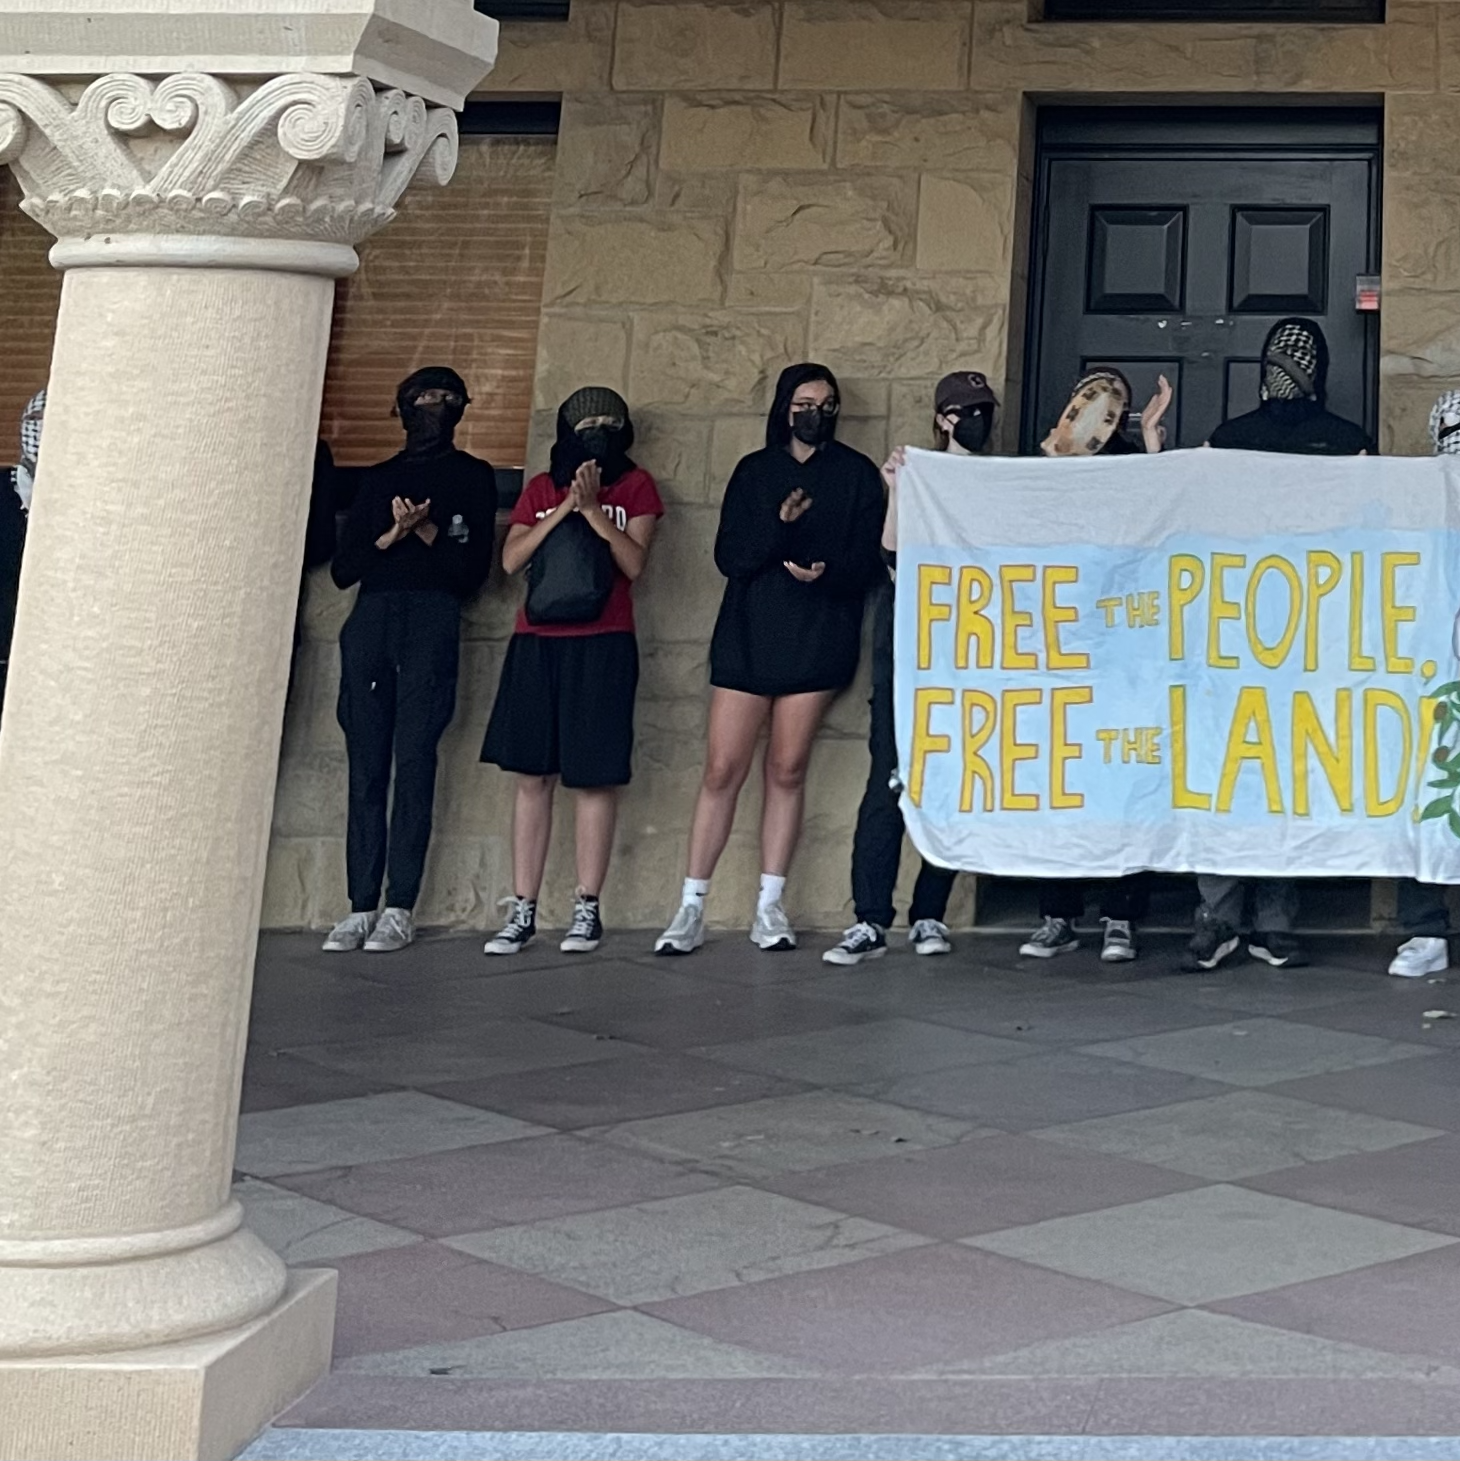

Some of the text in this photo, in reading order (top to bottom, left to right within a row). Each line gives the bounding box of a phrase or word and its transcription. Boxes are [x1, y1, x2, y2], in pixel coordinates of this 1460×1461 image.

[917, 549, 1438, 687] FREE THE PEOPLE,
[908, 684, 1438, 825] FREE THE LAND!
